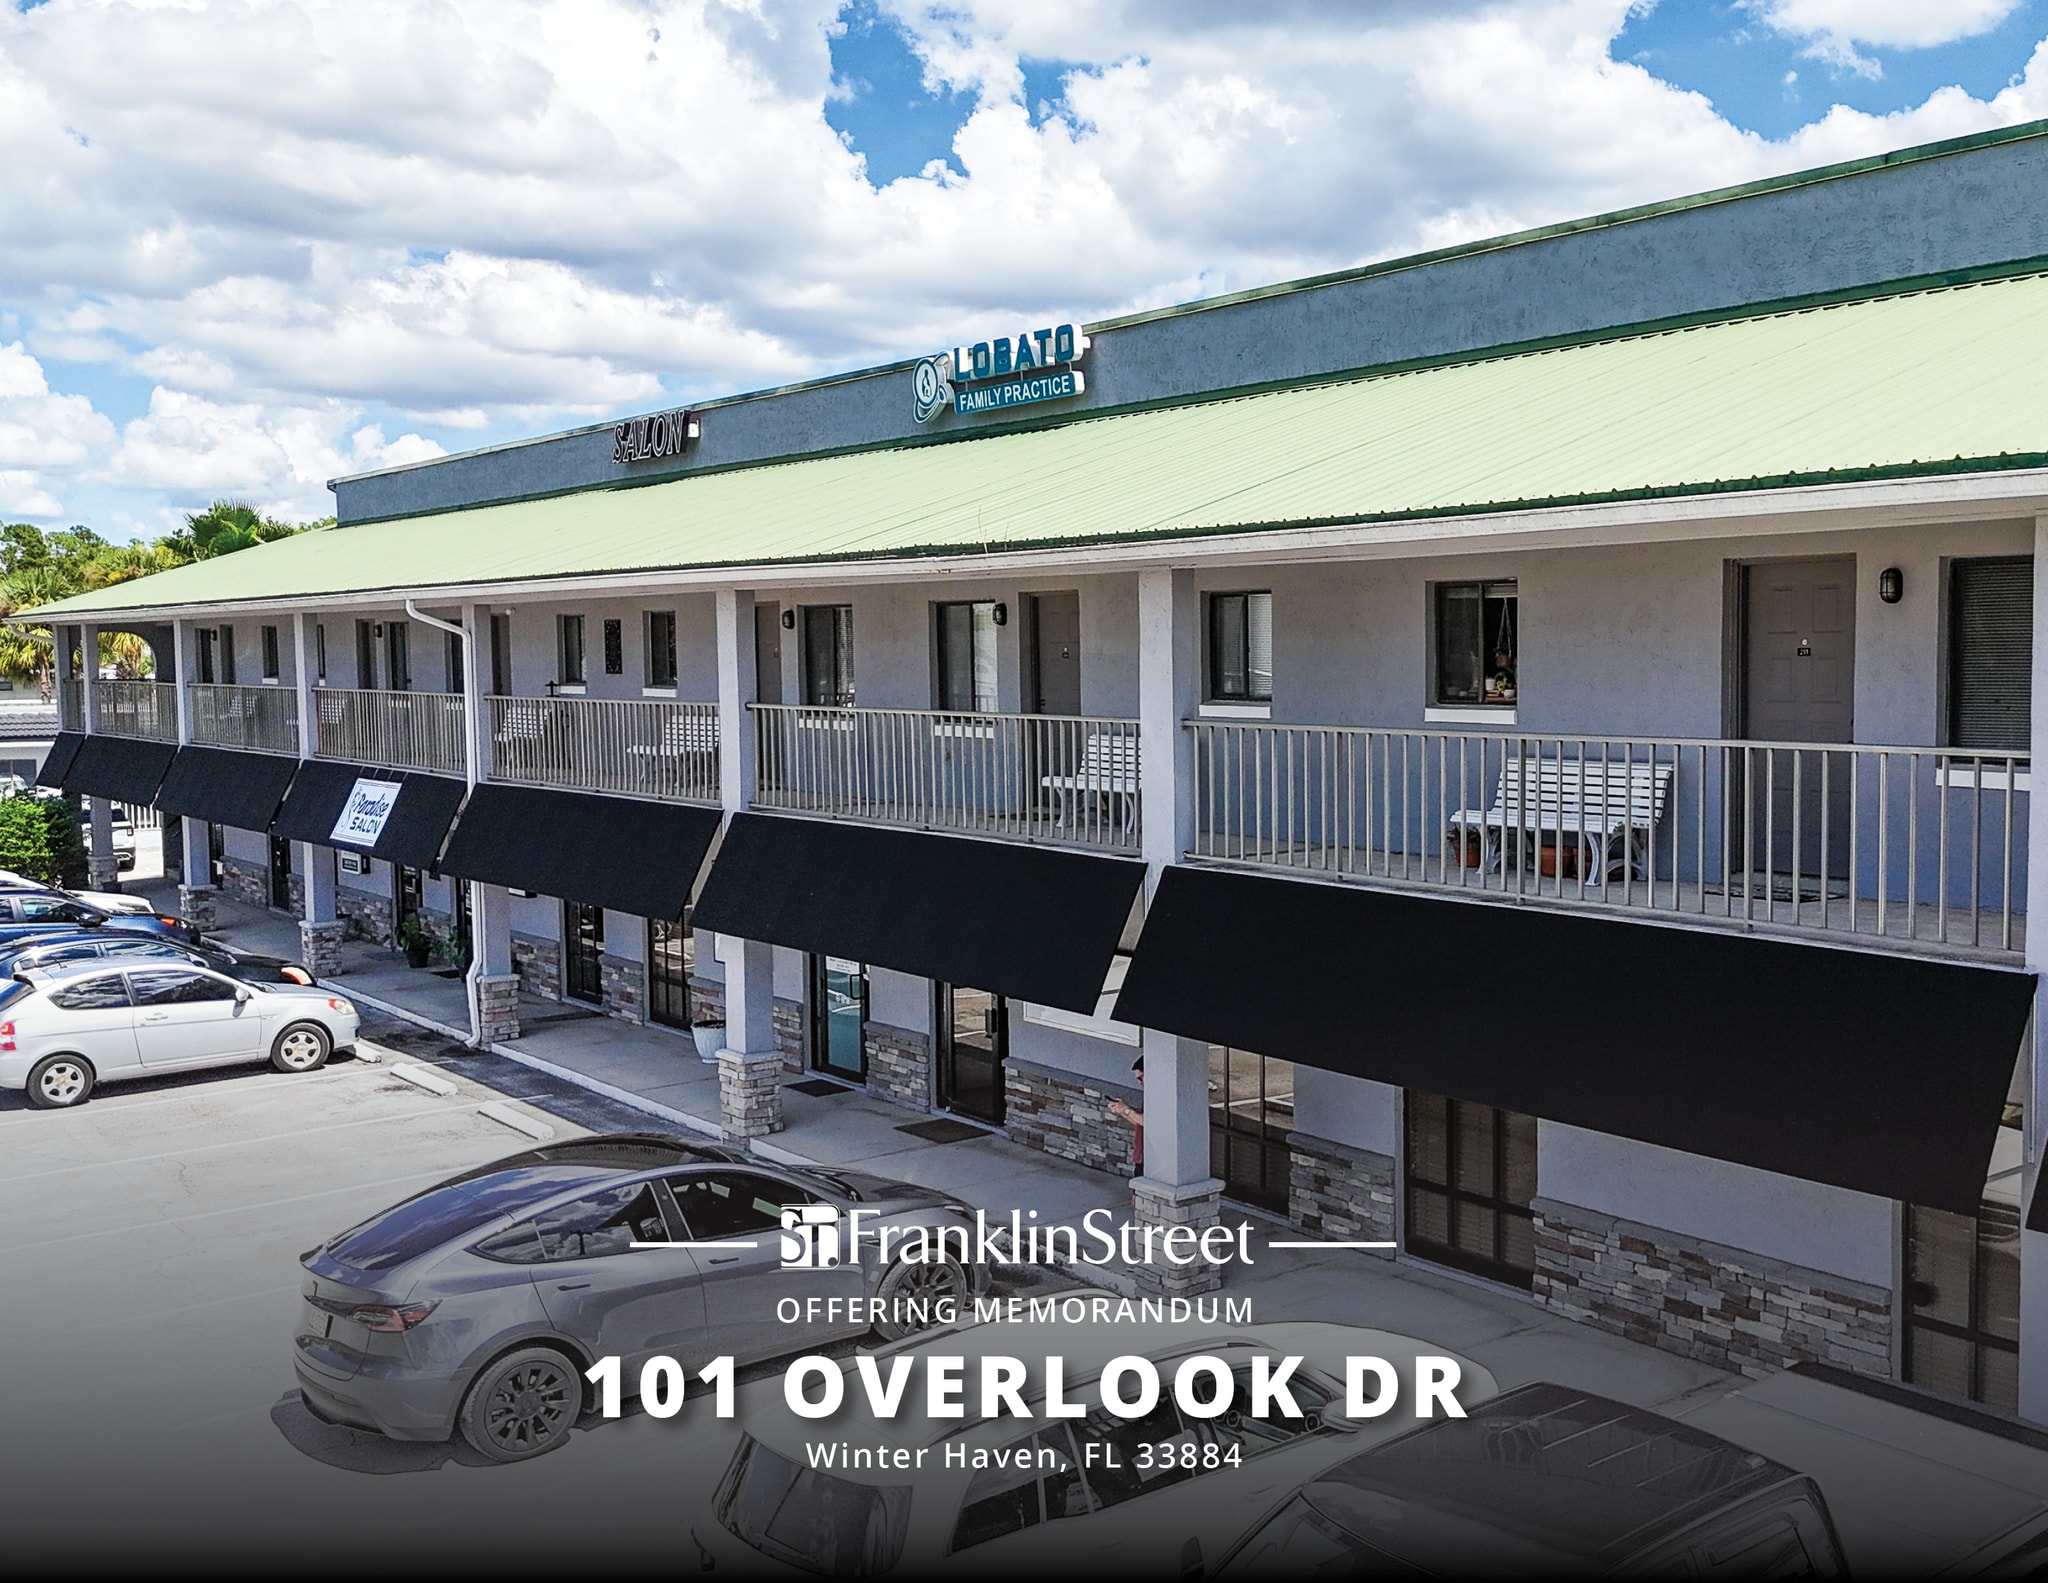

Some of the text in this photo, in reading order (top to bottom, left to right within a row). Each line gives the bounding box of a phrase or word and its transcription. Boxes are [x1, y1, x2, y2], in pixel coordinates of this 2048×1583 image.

[954, 324, 1074, 381] LOBATO
[960, 375, 1071, 412] FAMILY PRACTICE
[612, 410, 685, 463] SALON
[352, 793, 390, 818] Paradise
[349, 817, 382, 834] SALON
